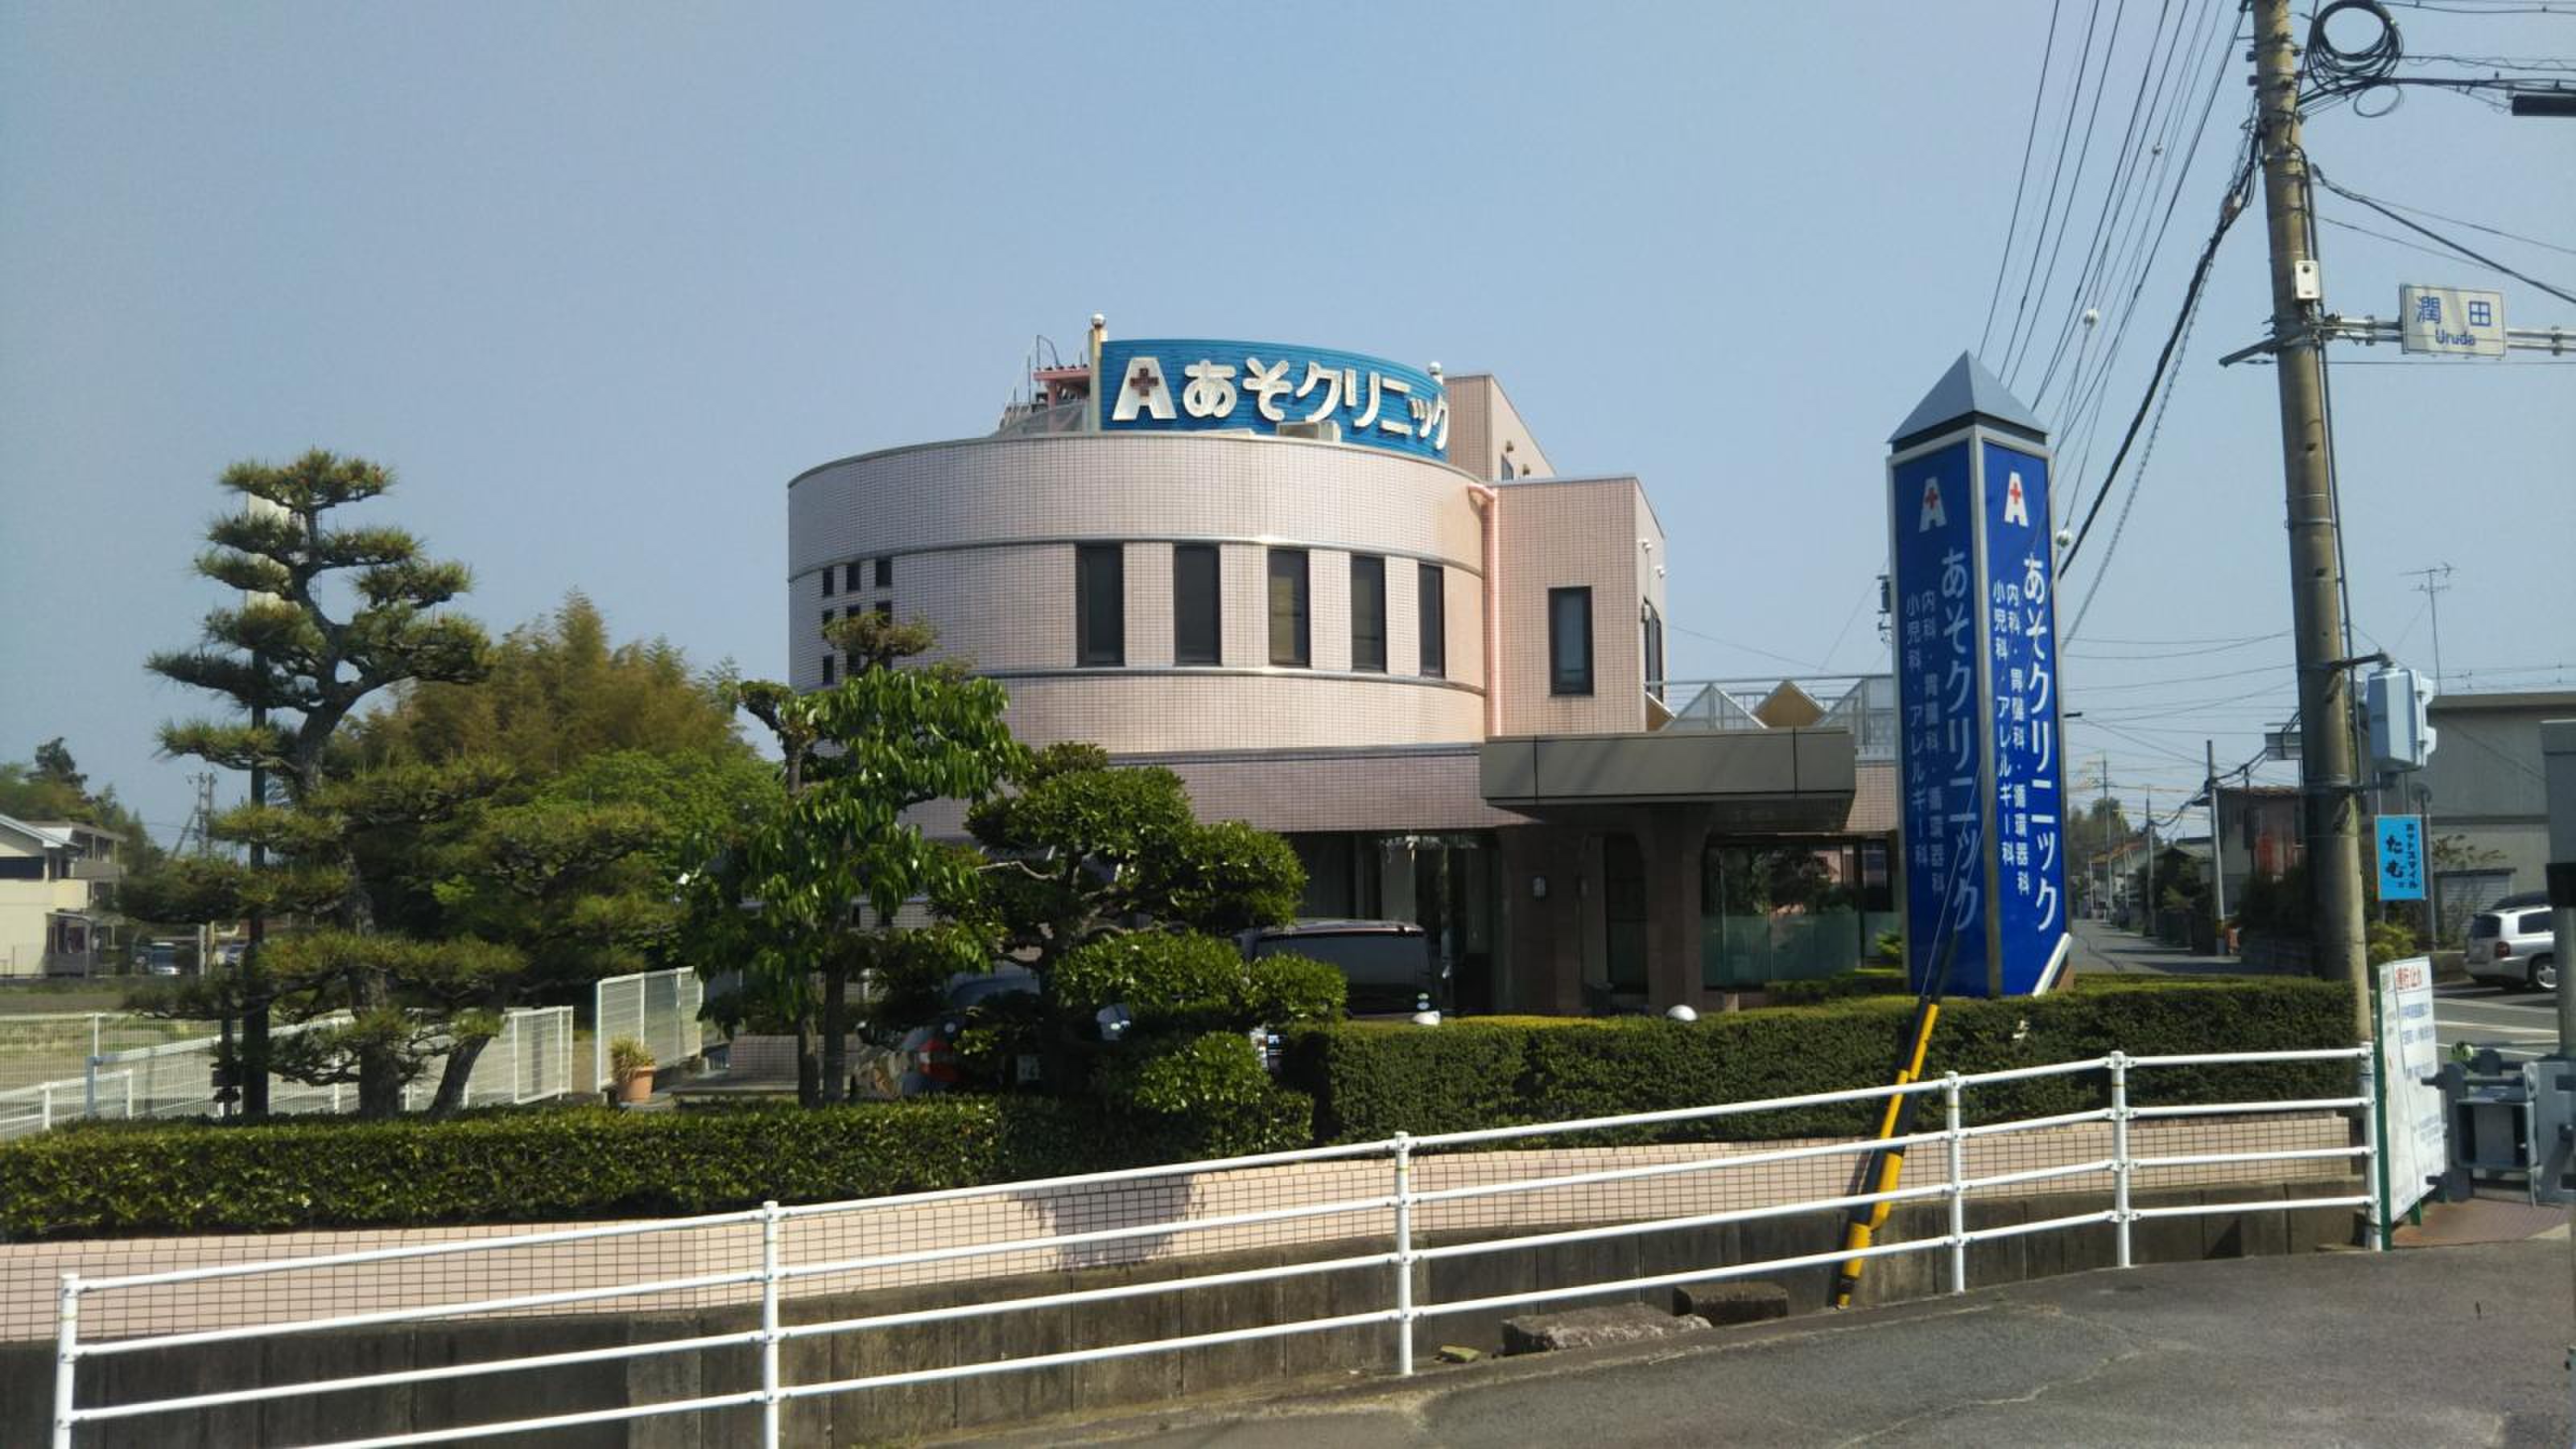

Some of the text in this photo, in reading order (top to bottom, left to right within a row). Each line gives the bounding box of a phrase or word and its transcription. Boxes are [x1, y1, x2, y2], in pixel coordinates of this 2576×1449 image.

[2417, 295, 2491, 327] 潤田
[2435, 328, 2476, 346] Uruda
[1183, 357, 1448, 451] あそクリニック
[1942, 547, 1979, 931] あそクリニック
[2024, 551, 2057, 931] あそクリニック
